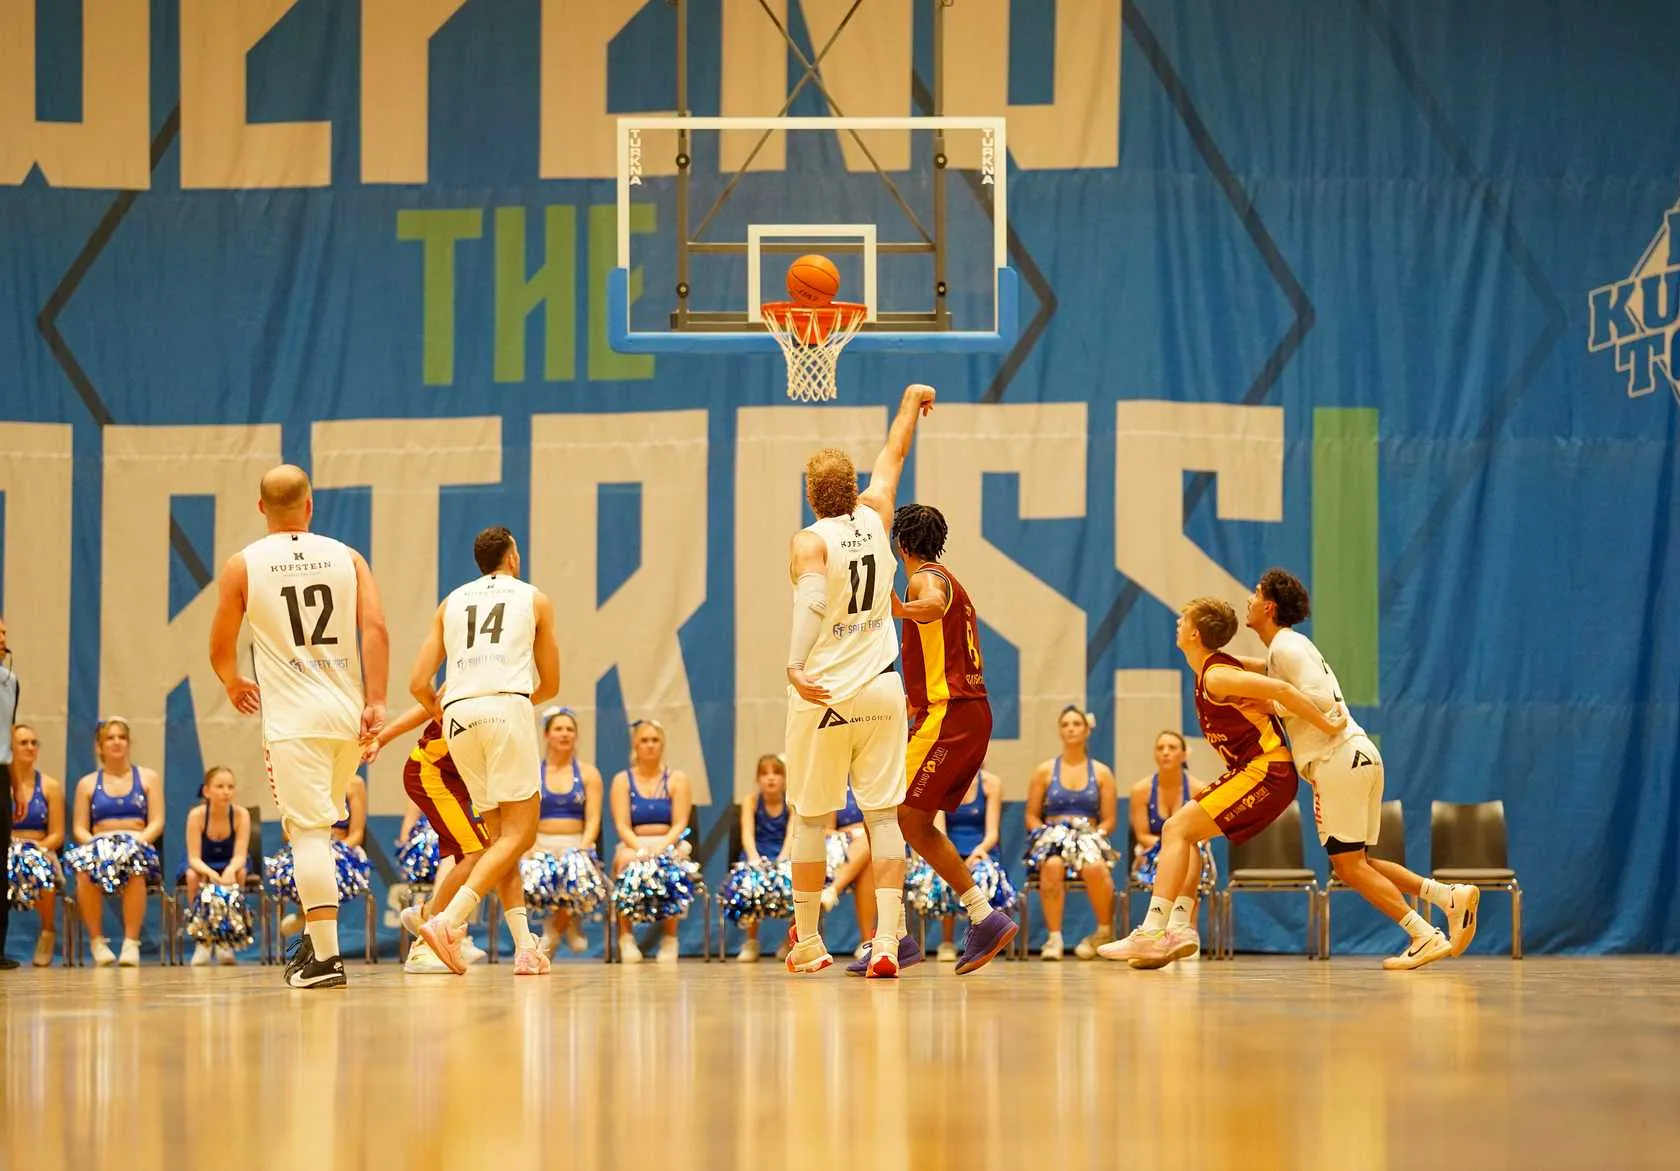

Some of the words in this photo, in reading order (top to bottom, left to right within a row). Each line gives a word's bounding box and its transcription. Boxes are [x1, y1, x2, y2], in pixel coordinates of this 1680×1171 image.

[397, 203, 657, 386] THE
[280, 583, 338, 647] 12
[847, 553, 876, 615] 11
[465, 602, 506, 649] 14
